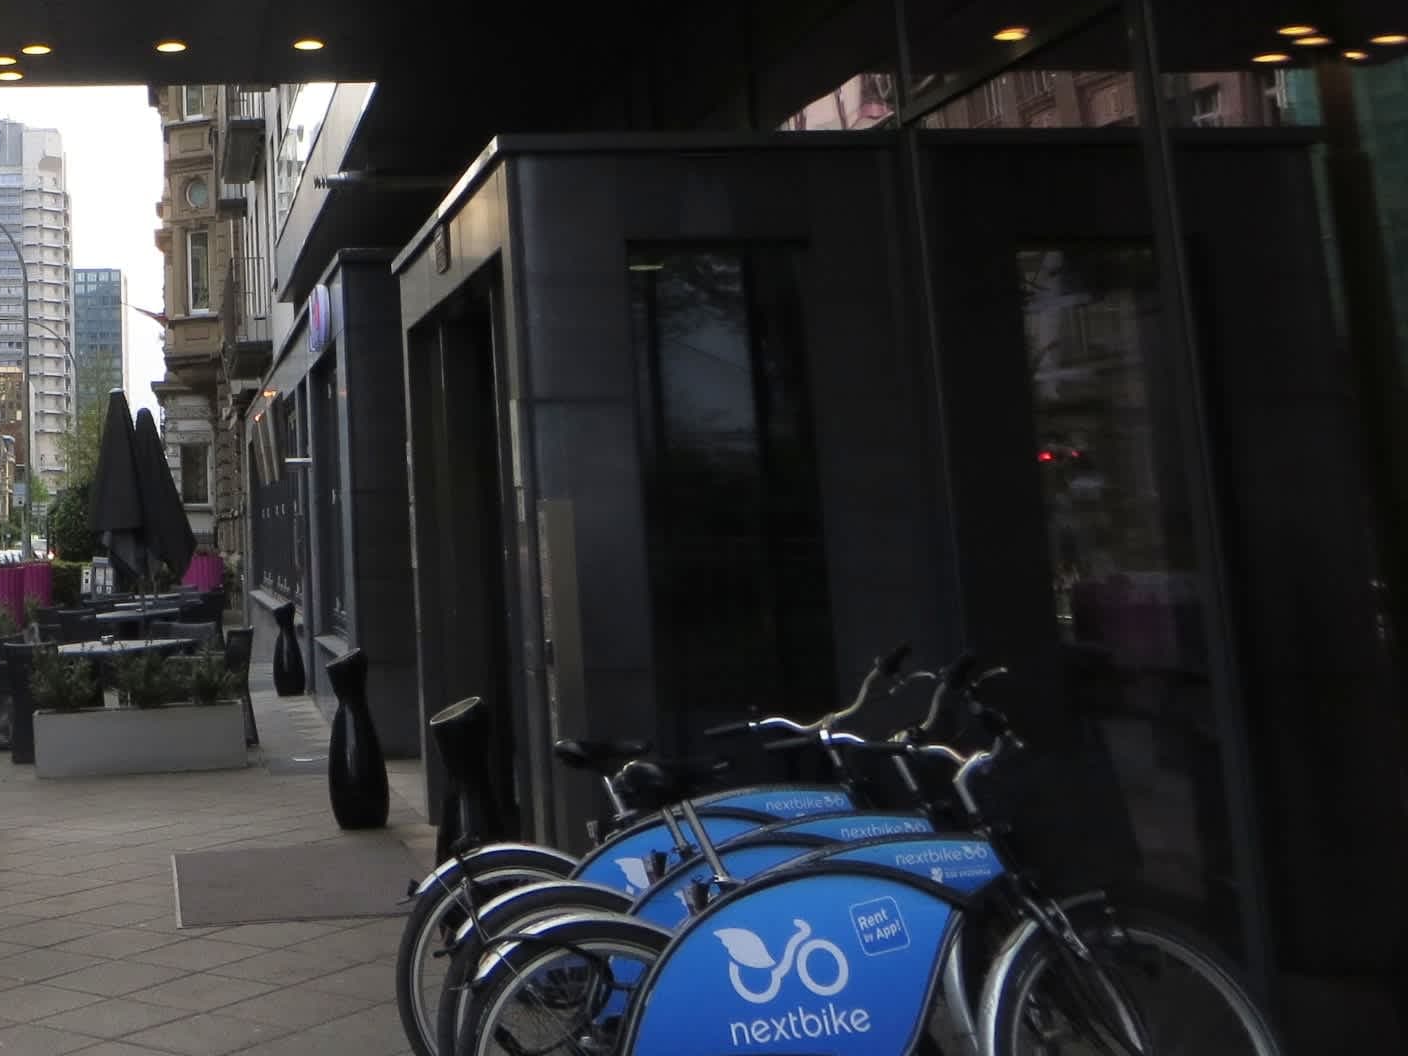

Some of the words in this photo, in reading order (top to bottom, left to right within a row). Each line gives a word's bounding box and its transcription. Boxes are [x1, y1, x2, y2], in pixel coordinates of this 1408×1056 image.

[766, 797, 823, 810] nextbike
[841, 824, 902, 839] nextbike
[895, 848, 962, 866] nextbike
[857, 908, 889, 931] Rent
[876, 919, 903, 941] App!
[730, 1003, 871, 1046] nextbike
